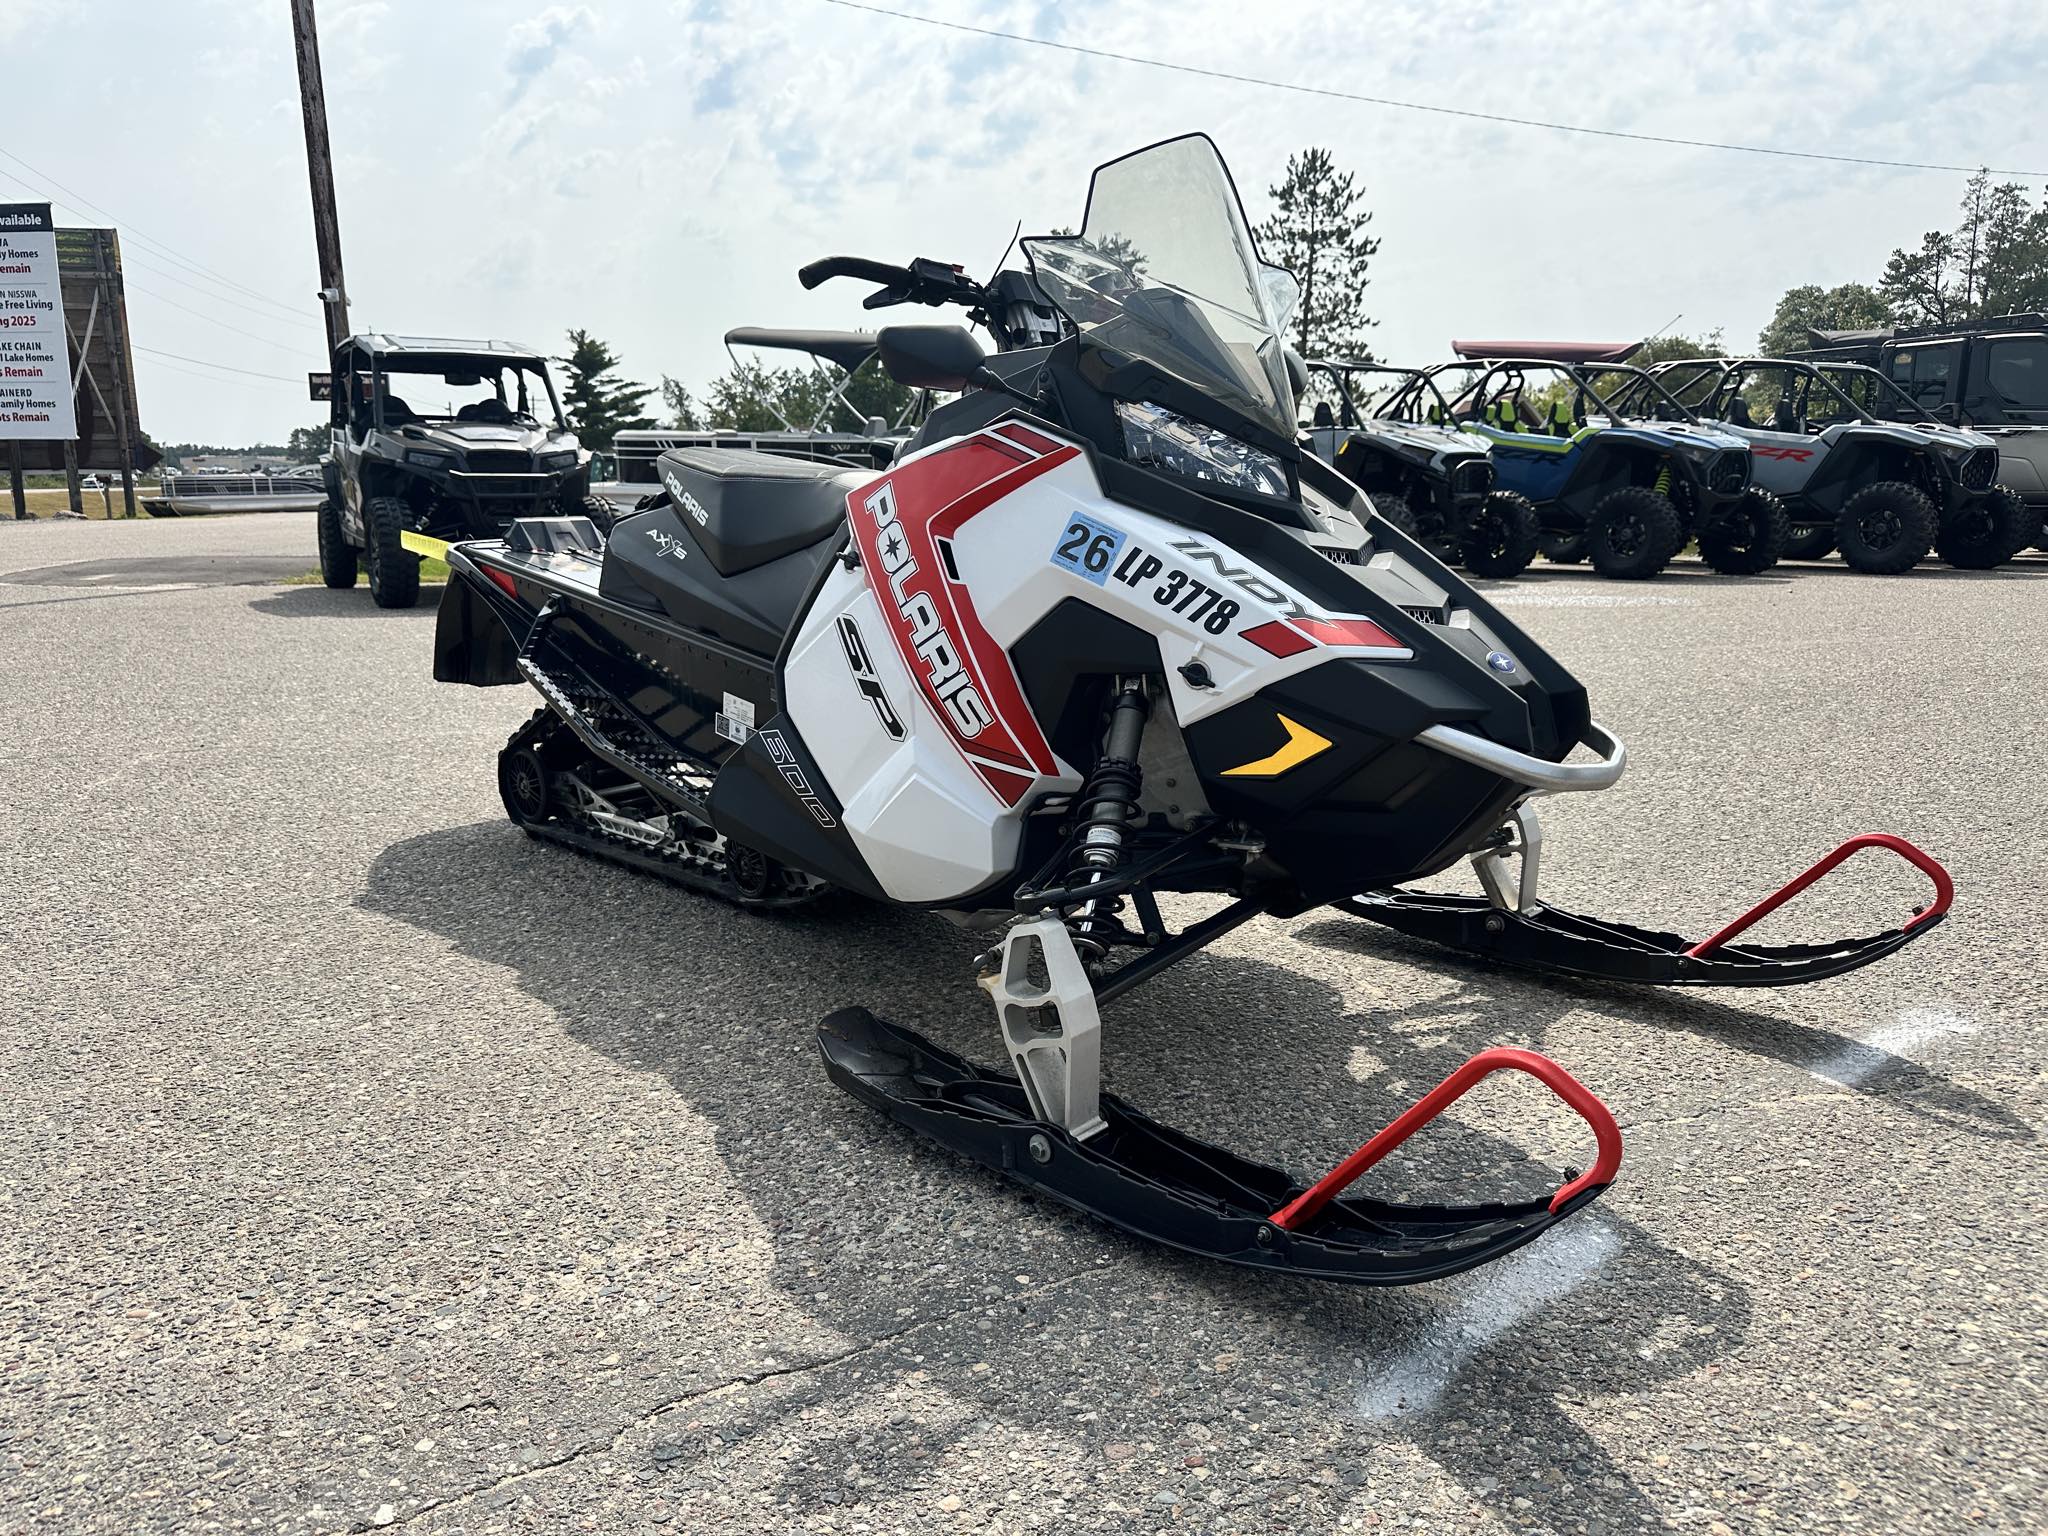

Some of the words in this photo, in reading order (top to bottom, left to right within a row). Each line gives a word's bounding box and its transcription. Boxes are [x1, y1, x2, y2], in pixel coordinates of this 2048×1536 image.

[8, 250, 39, 259] Homes
[8, 290, 37, 299] NISSWA
[5, 300, 24, 309] Free
[26, 299, 53, 311] Living
[11, 315, 36, 327] 2025
[0, 342, 12, 350] KE
[15, 342, 41, 351] CHAIN
[5, 353, 24, 362] Lake
[26, 353, 54, 362] Homes
[5, 366, 43, 377] Remain
[27, 400, 56, 408] Homes
[13, 411, 49, 422] Remain
[1750, 445, 1814, 463] ZR
[665, 470, 709, 527] POLARIS
[1057, 523, 1115, 573] 26
[1165, 536, 1342, 629] INDY
[1112, 546, 1163, 588] LP
[1153, 569, 1241, 635] 3778
[864, 479, 995, 740] POLARIS
[835, 614, 907, 741] SP
[759, 729, 837, 828] 500
